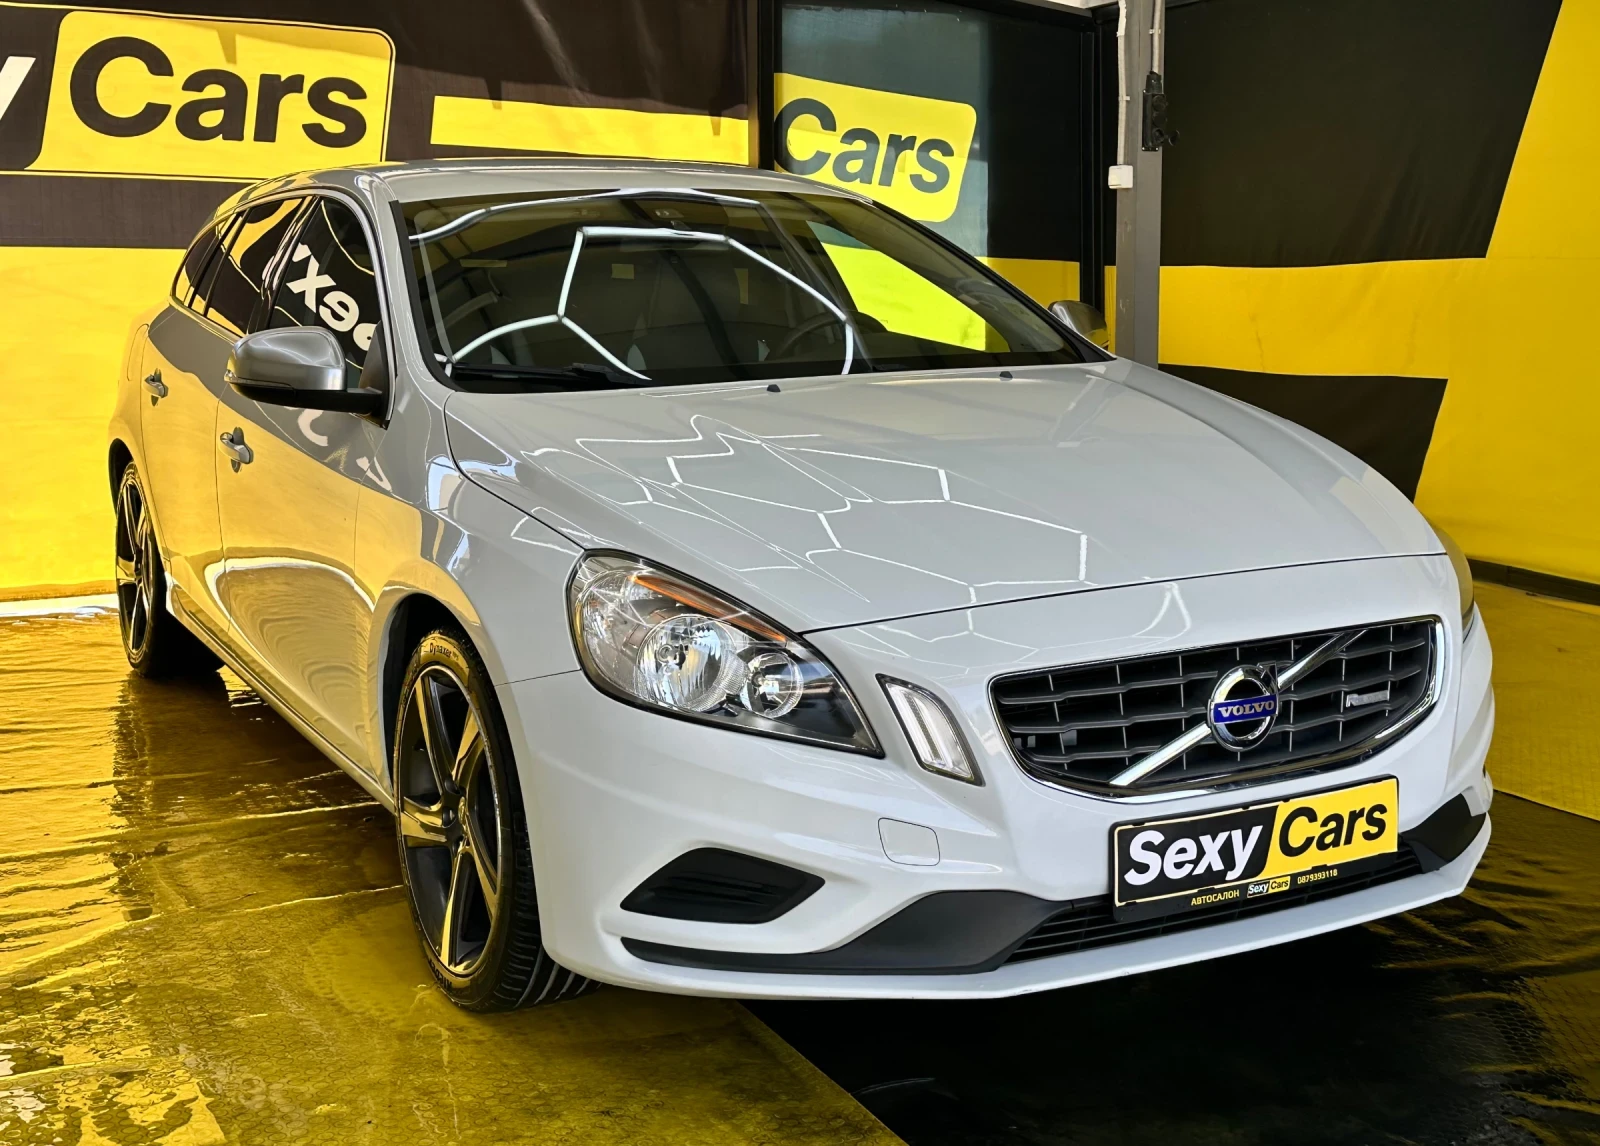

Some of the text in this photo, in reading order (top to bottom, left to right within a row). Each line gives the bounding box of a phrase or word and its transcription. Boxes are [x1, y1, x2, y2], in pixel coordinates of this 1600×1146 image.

[70, 36, 367, 148] Cars
[774, 97, 955, 194] Cars
[1217, 700, 1275, 718] VOLVO
[1123, 803, 1388, 885] Sexy Cars
[1190, 889, 1240, 906] АВТОСАЛОН
[1247, 877, 1289, 894] Sexy Cars
